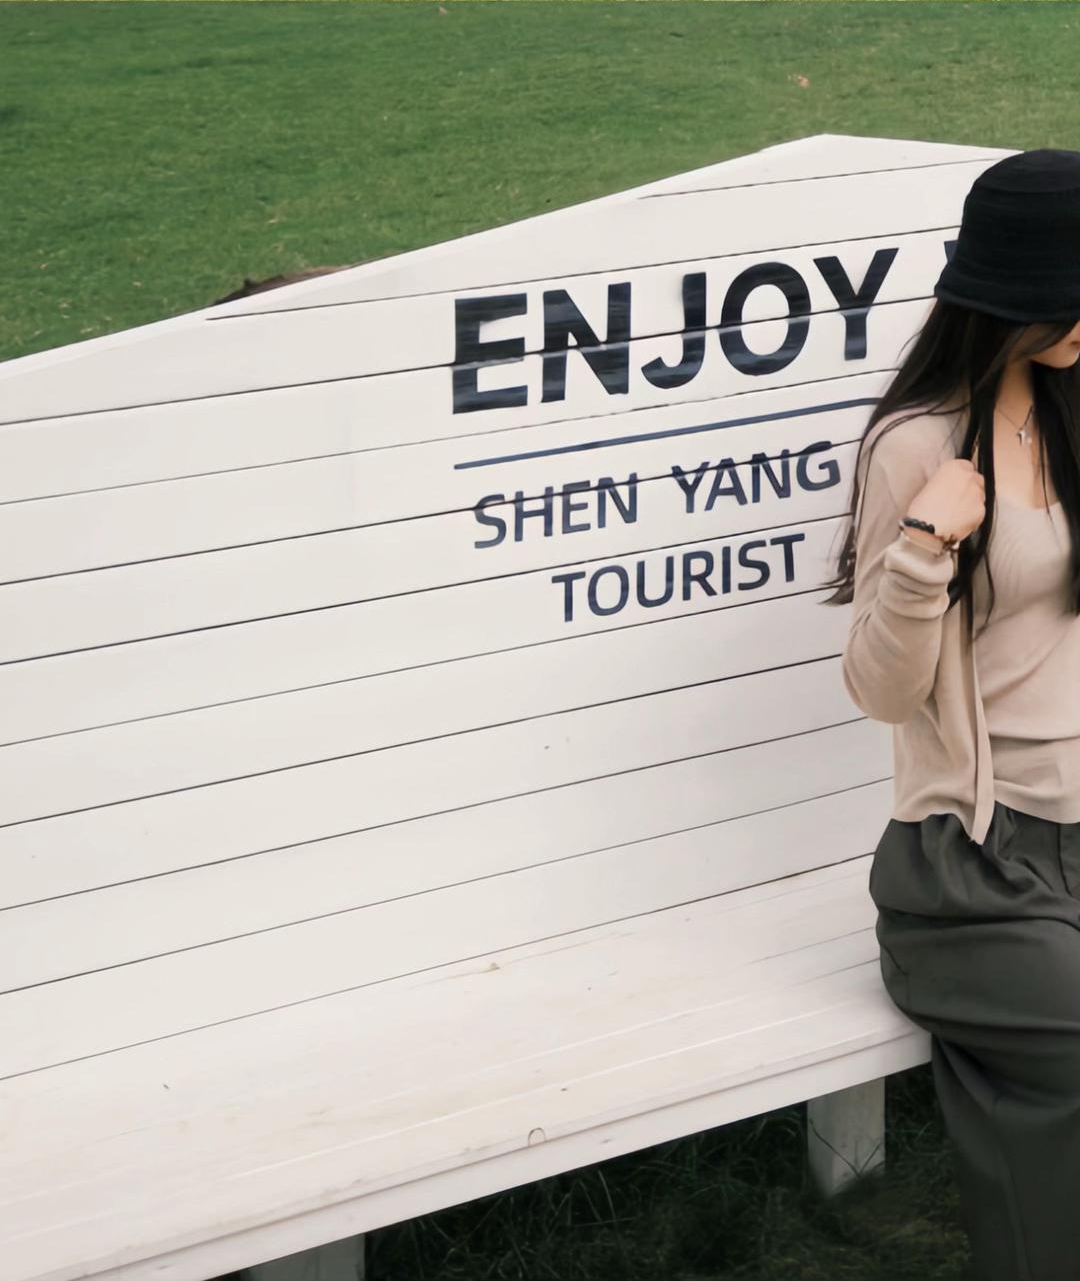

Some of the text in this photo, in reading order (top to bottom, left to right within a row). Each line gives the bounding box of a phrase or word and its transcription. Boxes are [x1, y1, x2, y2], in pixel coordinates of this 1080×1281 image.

[452, 247, 899, 415] ENJOY
[473, 472, 639, 550] SHEN
[671, 440, 842, 515] YANG
[552, 532, 806, 623] TOURIST
